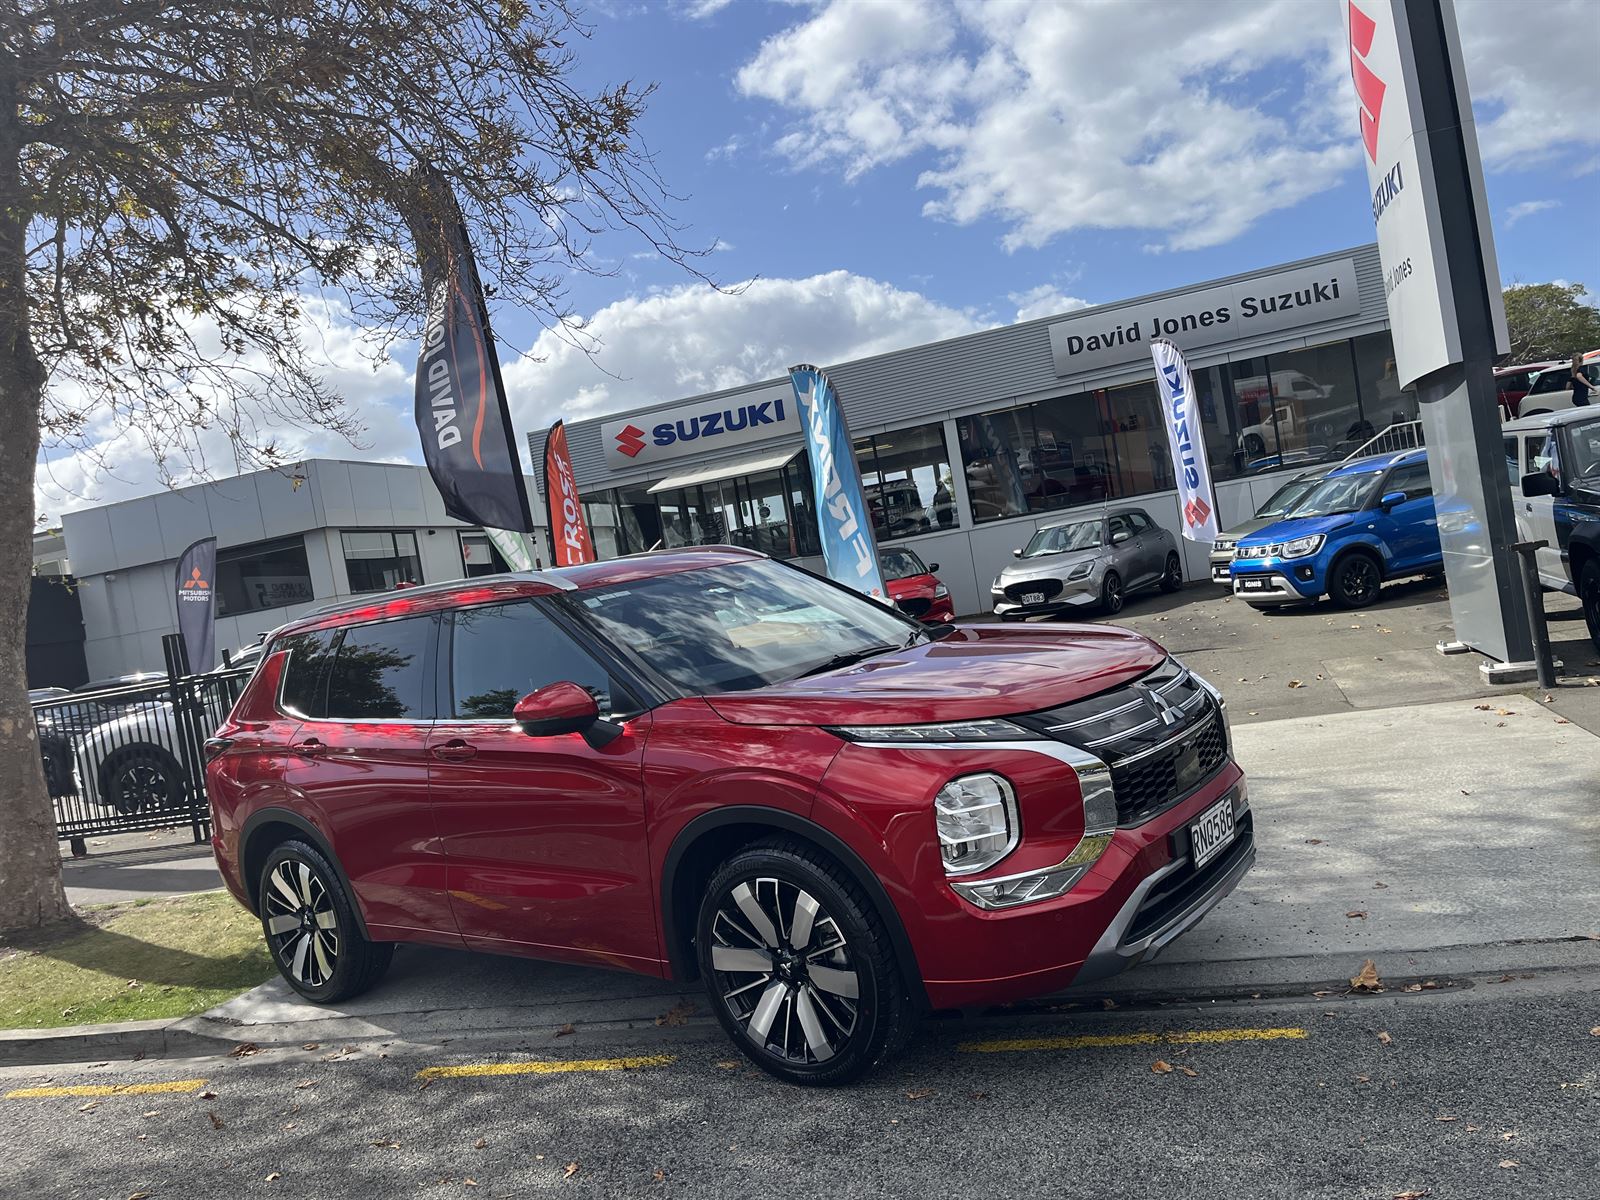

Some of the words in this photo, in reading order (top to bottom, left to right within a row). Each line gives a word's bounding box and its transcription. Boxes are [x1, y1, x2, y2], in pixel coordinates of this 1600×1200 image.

[1393, 257, 1412, 288] Jones
[1066, 321, 1141, 355] David
[1151, 305, 1230, 338] Jones
[1240, 278, 1340, 318] Suzuki
[654, 400, 786, 445] SUZUKI
[1192, 802, 1233, 858] RNQ586
